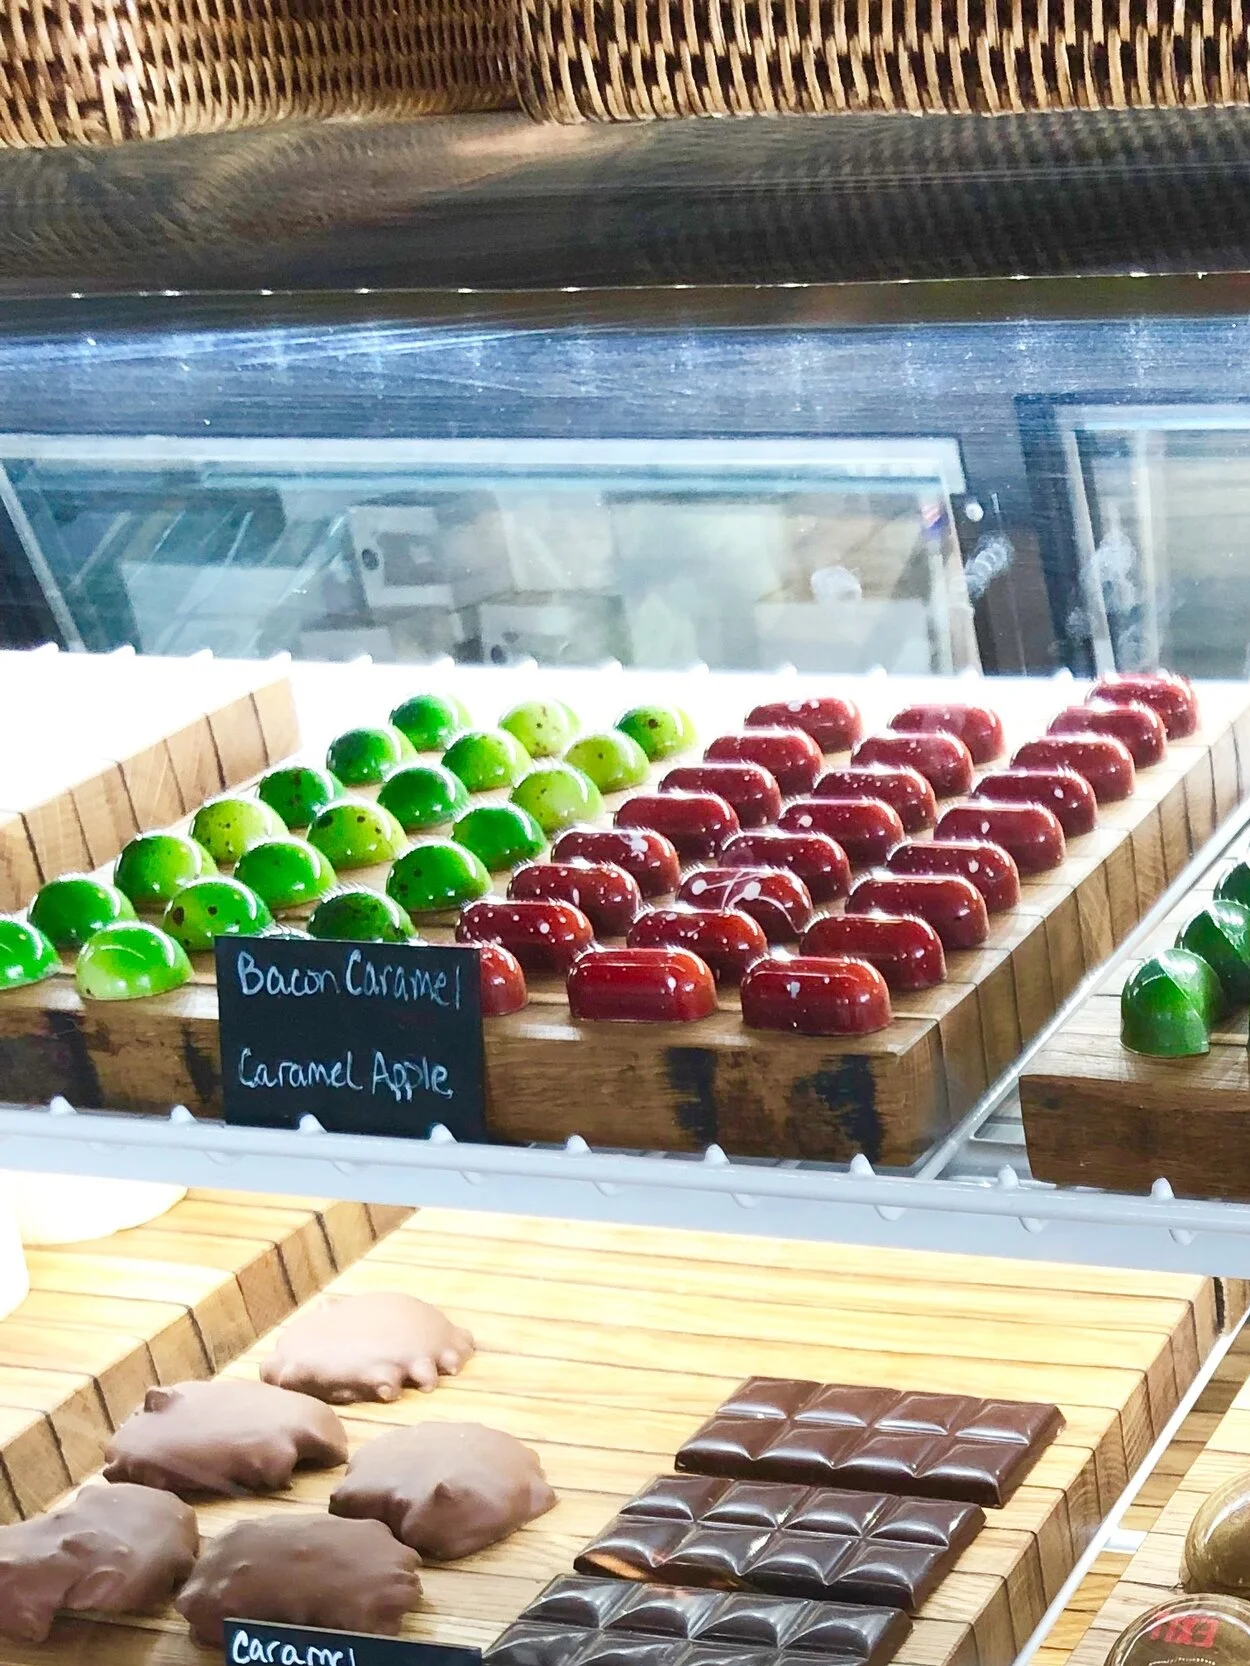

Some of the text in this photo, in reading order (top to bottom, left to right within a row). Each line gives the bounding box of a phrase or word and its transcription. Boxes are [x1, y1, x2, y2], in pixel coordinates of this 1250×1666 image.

[237, 949, 461, 1010] Bacon Caramel
[238, 1047, 454, 1102] Caramel Apple
